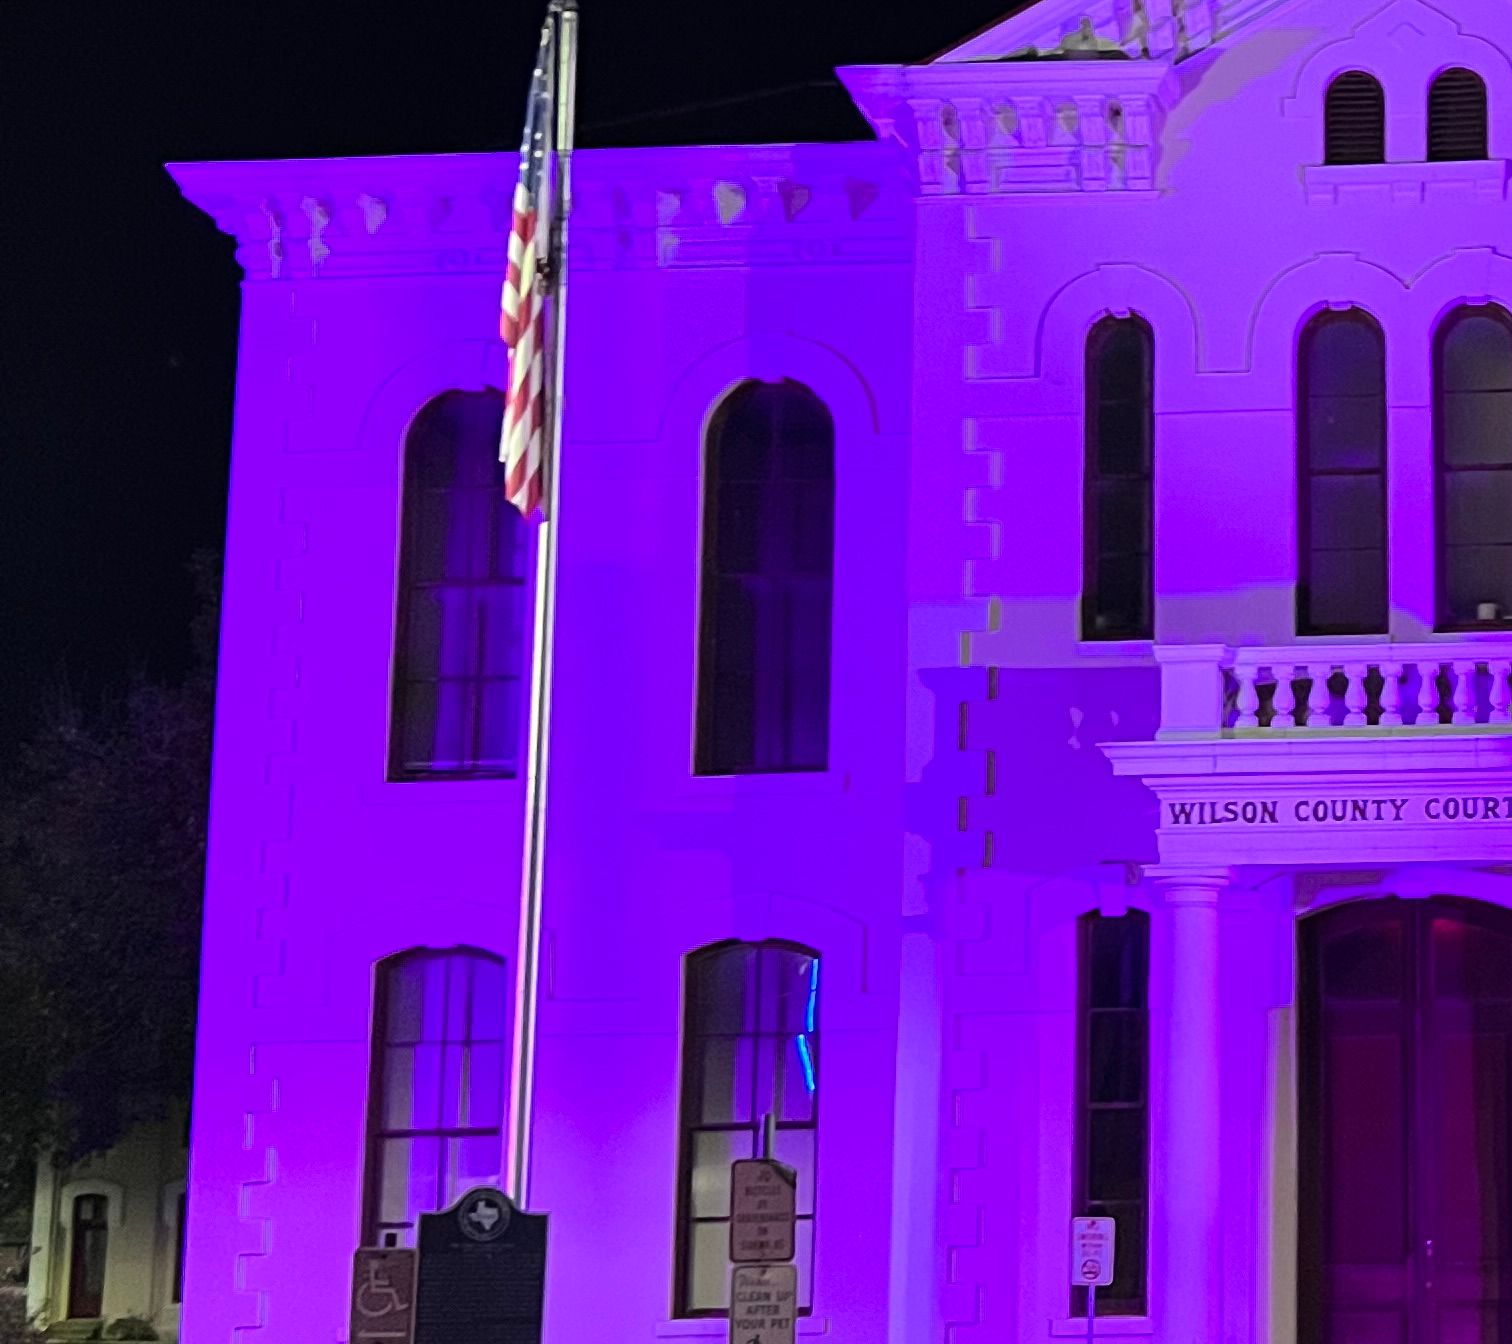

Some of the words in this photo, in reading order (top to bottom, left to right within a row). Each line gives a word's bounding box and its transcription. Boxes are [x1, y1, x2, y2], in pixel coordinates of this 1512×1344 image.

[1168, 800, 1279, 824] WILSON
[1294, 798, 1410, 823] COUNTY
[736, 1291, 771, 1302] CLEAN
[746, 1304, 780, 1315] AFTER
[735, 1318, 766, 1330] YOUR
[771, 1318, 791, 1330] PET
